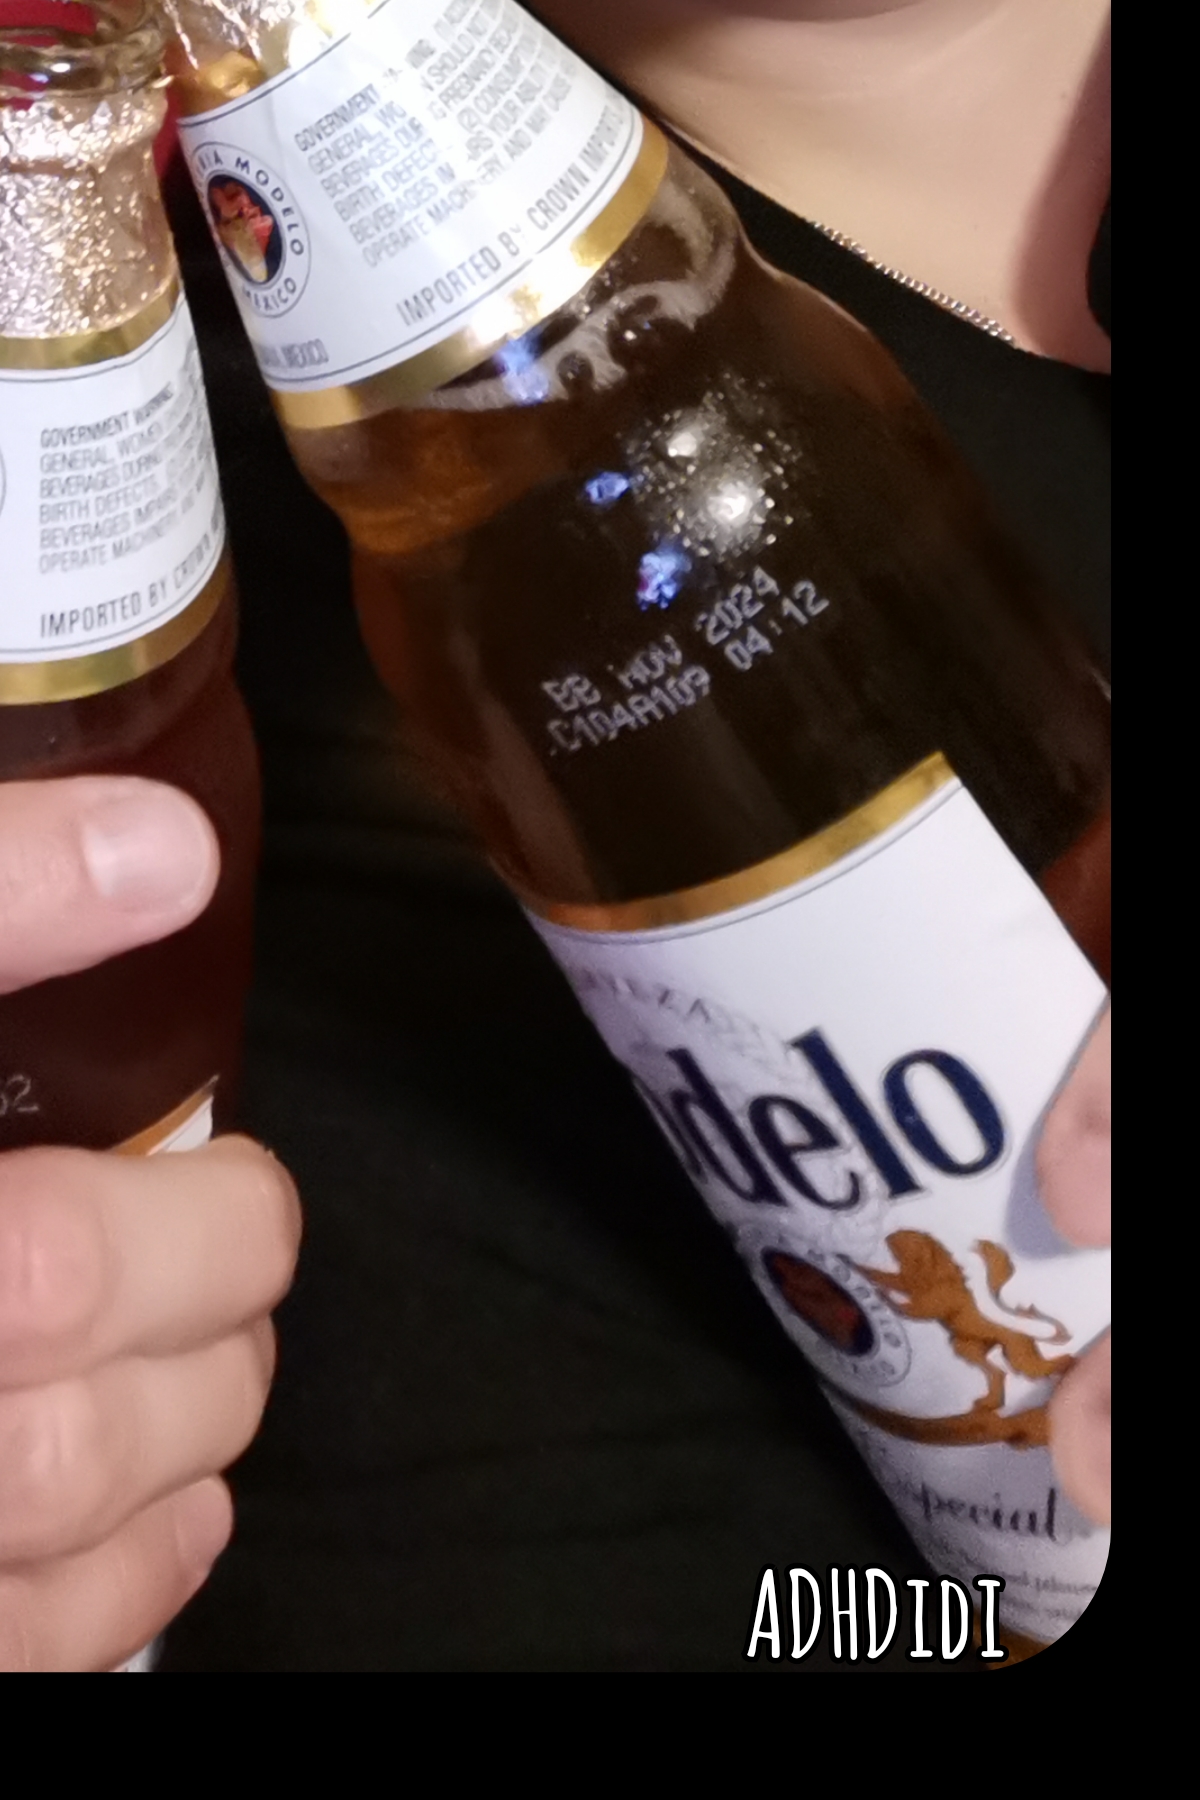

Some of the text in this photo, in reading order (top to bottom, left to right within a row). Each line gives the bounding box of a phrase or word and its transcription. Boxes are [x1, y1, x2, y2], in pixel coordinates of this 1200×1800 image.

[294, 83, 380, 151] GOVERNMENT
[234, 156, 304, 256] MODELO
[349, 176, 439, 245] BEVERAGES
[396, 245, 503, 327] IMPORTED
[527, 162, 592, 232] CROWN
[39, 410, 130, 449] GOVERNMENT
[39, 464, 120, 499] BEVERAGES
[39, 499, 90, 525] BIRTH
[39, 511, 131, 550] BEVERAGES
[39, 543, 107, 575] OPERATE
[40, 591, 142, 639] IMPORTED
[148, 579, 168, 608] BY
[695, 566, 780, 646] 2024
